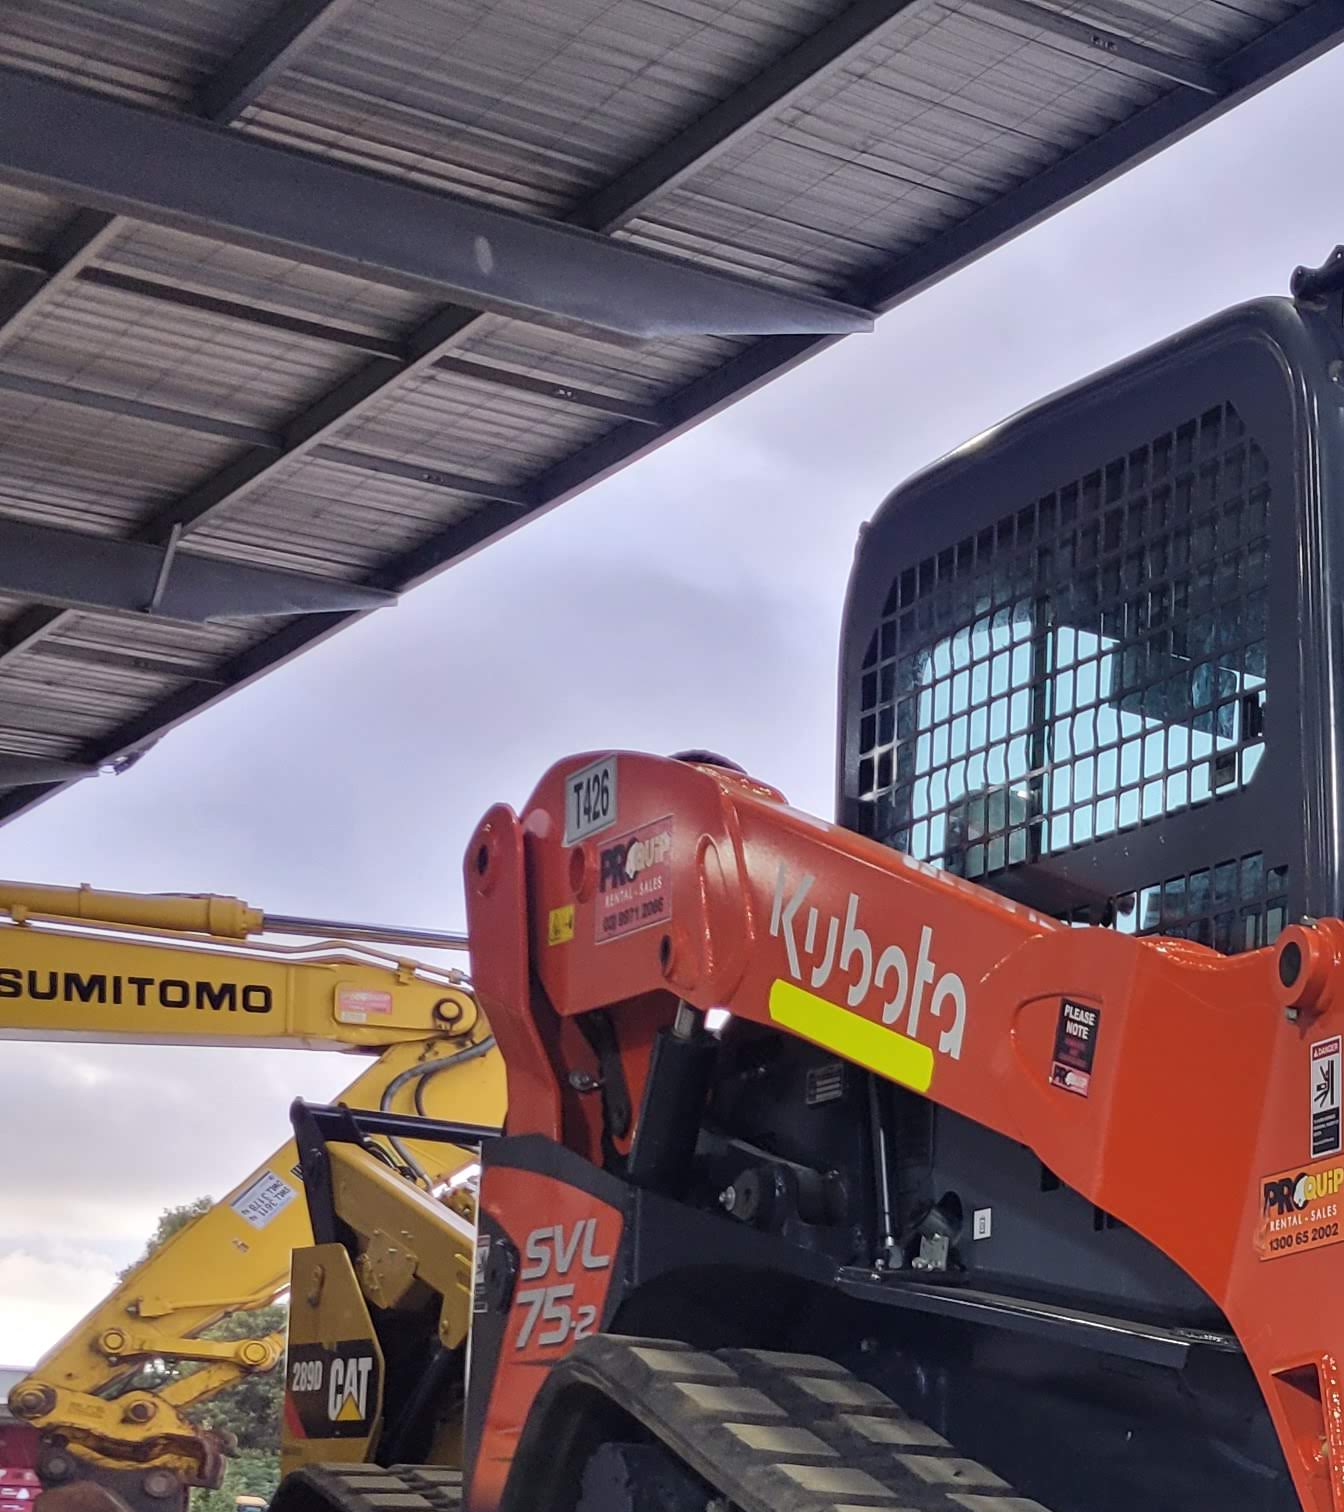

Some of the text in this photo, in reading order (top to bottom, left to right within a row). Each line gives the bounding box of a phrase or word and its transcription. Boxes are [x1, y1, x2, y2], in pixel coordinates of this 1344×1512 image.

[574, 769, 609, 829] T426
[770, 862, 967, 1061] Kubota
[0, 967, 273, 1014] SUMITOMO
[1064, 1004, 1096, 1026] PLEASE
[1066, 1021, 1089, 1040] NOTE
[1270, 1214, 1302, 1232] RENTAL
[1311, 1204, 1337, 1222] SALES
[1270, 1222, 1339, 1252] 1300 65 2002
[520, 1218, 609, 1281] SVL
[515, 1283, 596, 1349] 75-2
[292, 1360, 323, 1392] 289D
[328, 1356, 373, 1421] CAT
